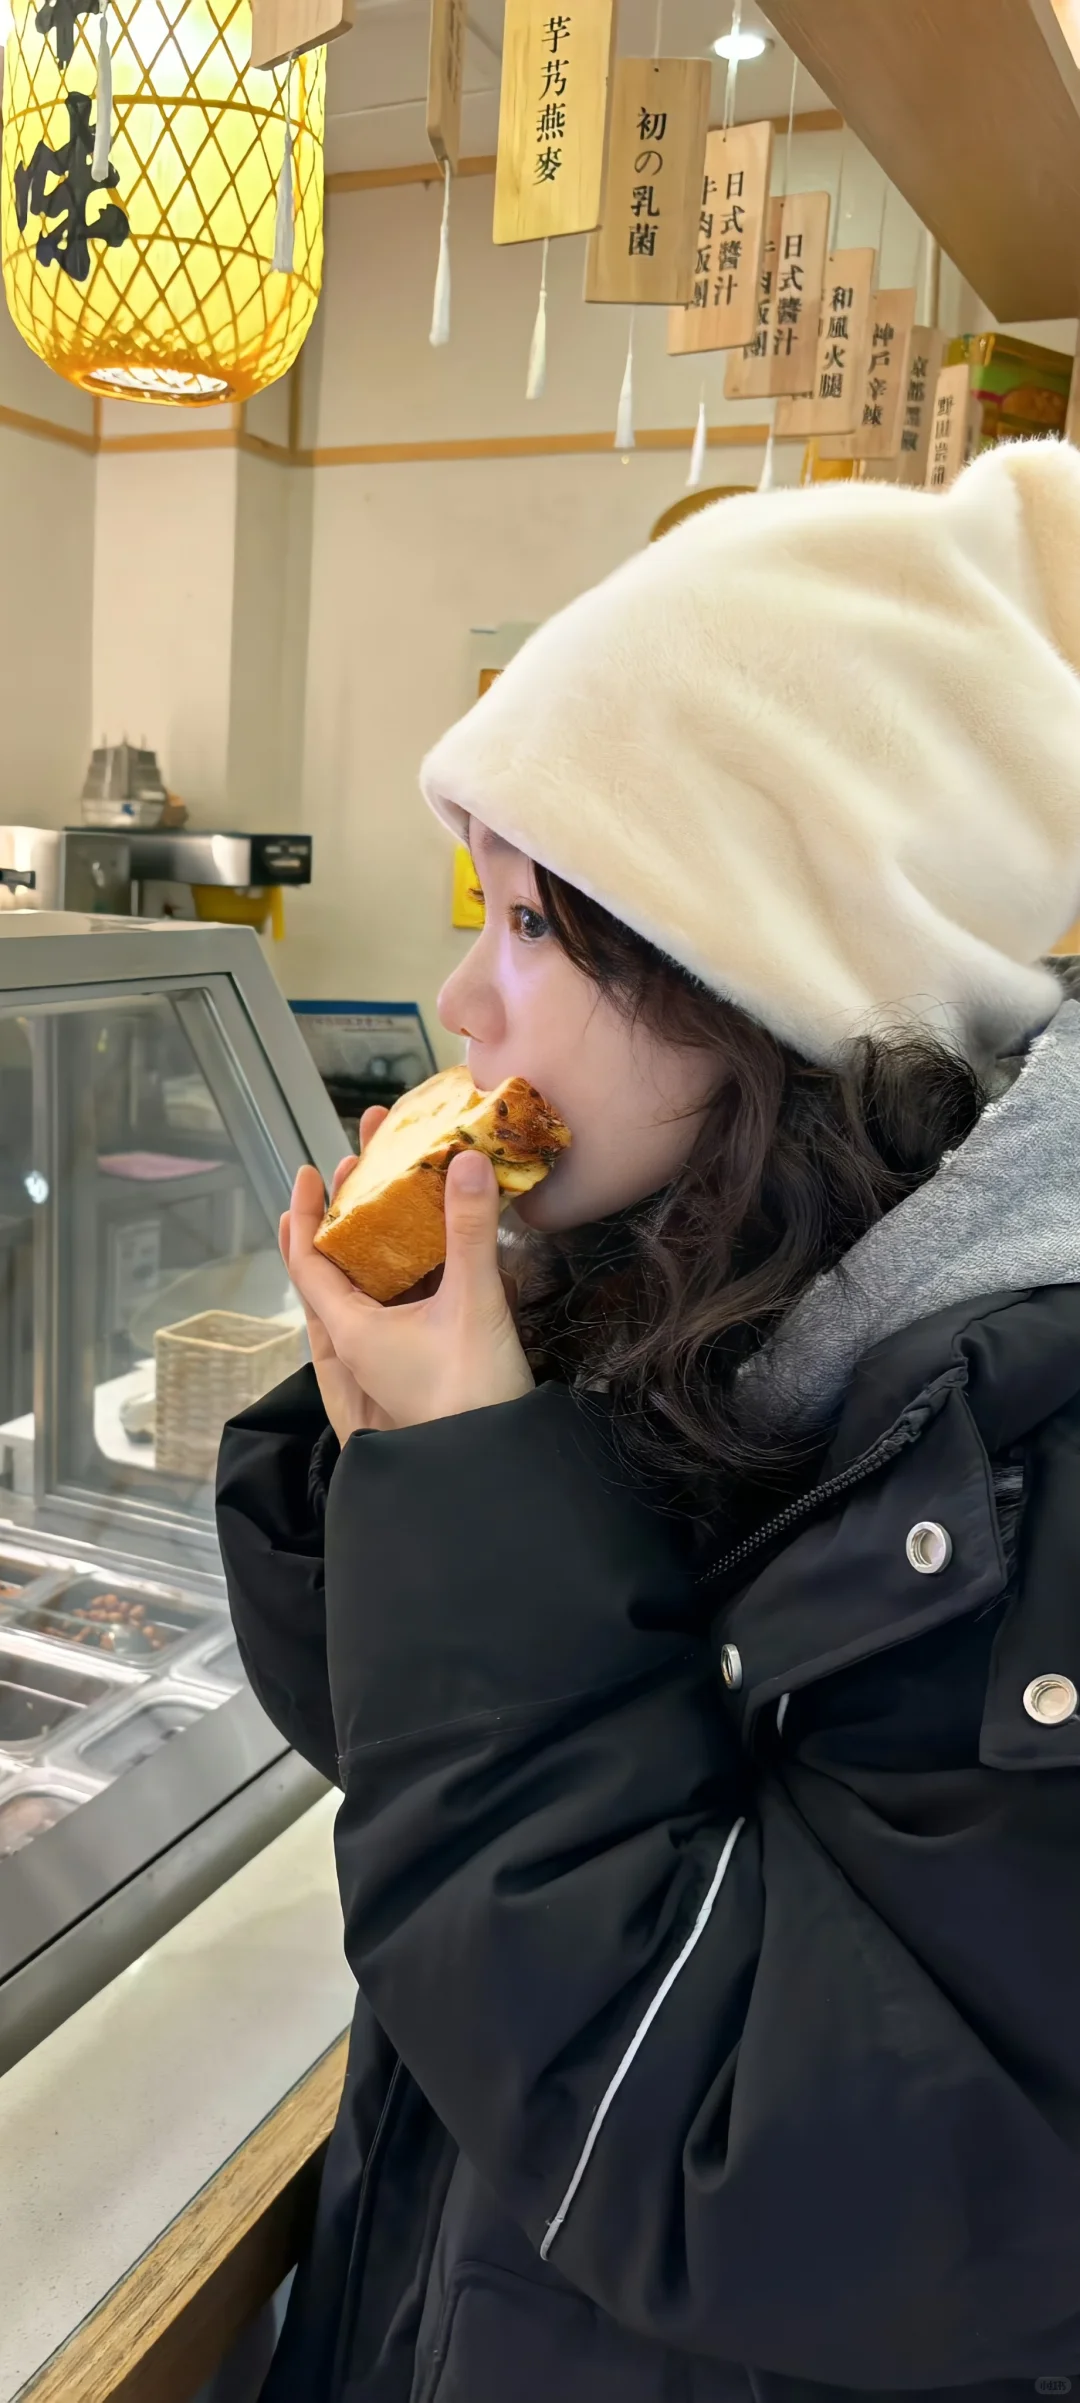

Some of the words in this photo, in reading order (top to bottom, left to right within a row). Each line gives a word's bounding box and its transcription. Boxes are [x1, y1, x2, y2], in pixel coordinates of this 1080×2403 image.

[533, 15, 571, 186] 芋艿燕麥
[628, 107, 667, 256] 初の乳菌
[714, 171, 745, 306] 日式醬汁
[773, 234, 804, 356] 日式醬汁
[819, 286, 853, 399] 和風火腿
